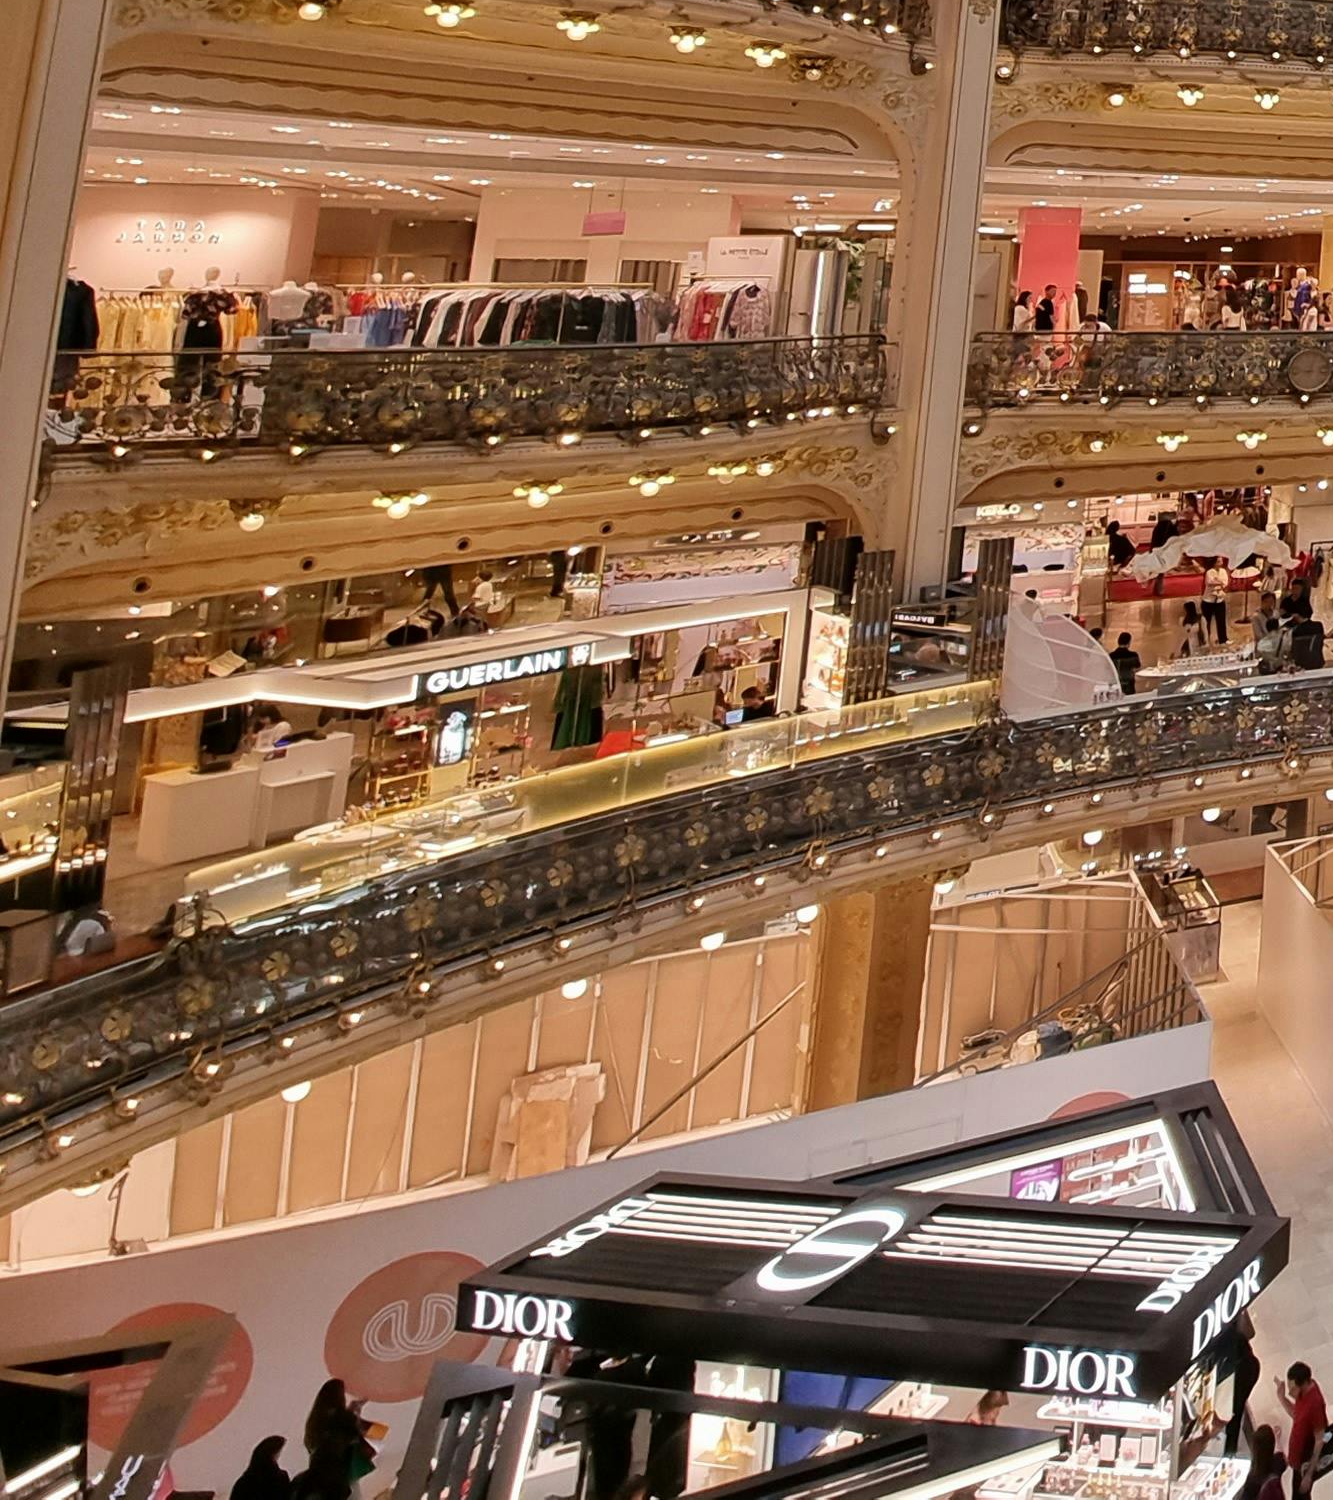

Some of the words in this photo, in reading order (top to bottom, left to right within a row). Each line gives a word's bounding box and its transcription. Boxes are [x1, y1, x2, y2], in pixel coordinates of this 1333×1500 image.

[426, 650, 562, 694] GUERLAIN
[1135, 1238, 1240, 1315] DIOR
[471, 1289, 575, 1342] DIOR
[1190, 1258, 1262, 1361] DIOR
[1019, 1346, 1137, 1398] DIOR
